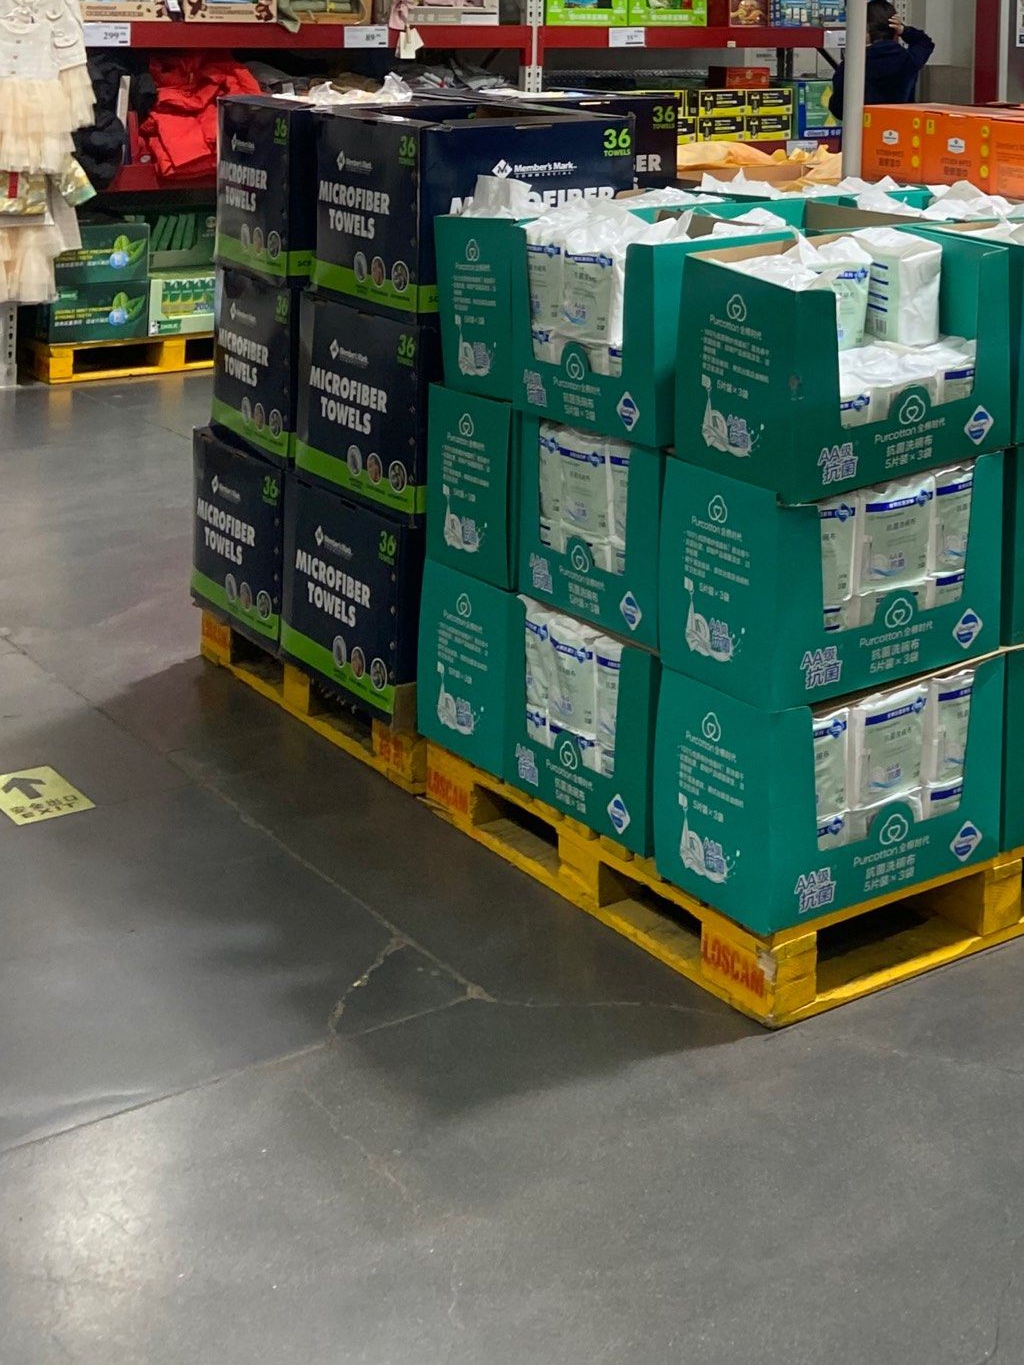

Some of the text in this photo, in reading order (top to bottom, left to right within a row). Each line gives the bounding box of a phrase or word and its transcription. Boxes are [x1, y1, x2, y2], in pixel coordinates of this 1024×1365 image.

[653, 106, 675, 122] 36
[274, 118, 288, 137] 36
[603, 128, 631, 149] 36
[400, 136, 416, 156] 36
[603, 149, 631, 157] TOWELS
[220, 160, 267, 190] MICROFIBER
[514, 161, 574, 173] Member's Mark
[633, 155, 662, 172] ER
[226, 185, 256, 212] TOWELS
[318, 180, 390, 215] MICROFIBER
[329, 208, 375, 239] TOWELS
[275, 295, 288, 314] 36
[218, 328, 269, 367] MICROFIBER
[397, 335, 416, 357] 36
[224, 354, 258, 387] TOWELS
[309, 365, 388, 413] MICROFIBER
[320, 396, 372, 435] TOWELS
[874, 426, 917, 445] Purcotton
[817, 442, 854, 466] AA级
[822, 456, 858, 485] 抗菌
[263, 475, 278, 498] 36
[197, 497, 255, 547] MICROFIBER
[205, 526, 243, 565] TOWELS
[378, 531, 395, 556] 36
[295, 549, 371, 609] MICROFIBER
[307, 581, 356, 628] TOWELS
[859, 630, 902, 648] Purcotton
[800, 646, 839, 670] AA级
[805, 662, 842, 690] 抗菌
[10, 795, 78, 814] 安全出口
[21, 802, 76, 818] EXIT
[853, 848, 899, 868] Purcotton
[794, 867, 833, 893] AA级
[799, 883, 836, 914] 抗菌
[703, 936, 766, 998] LOSCAM
